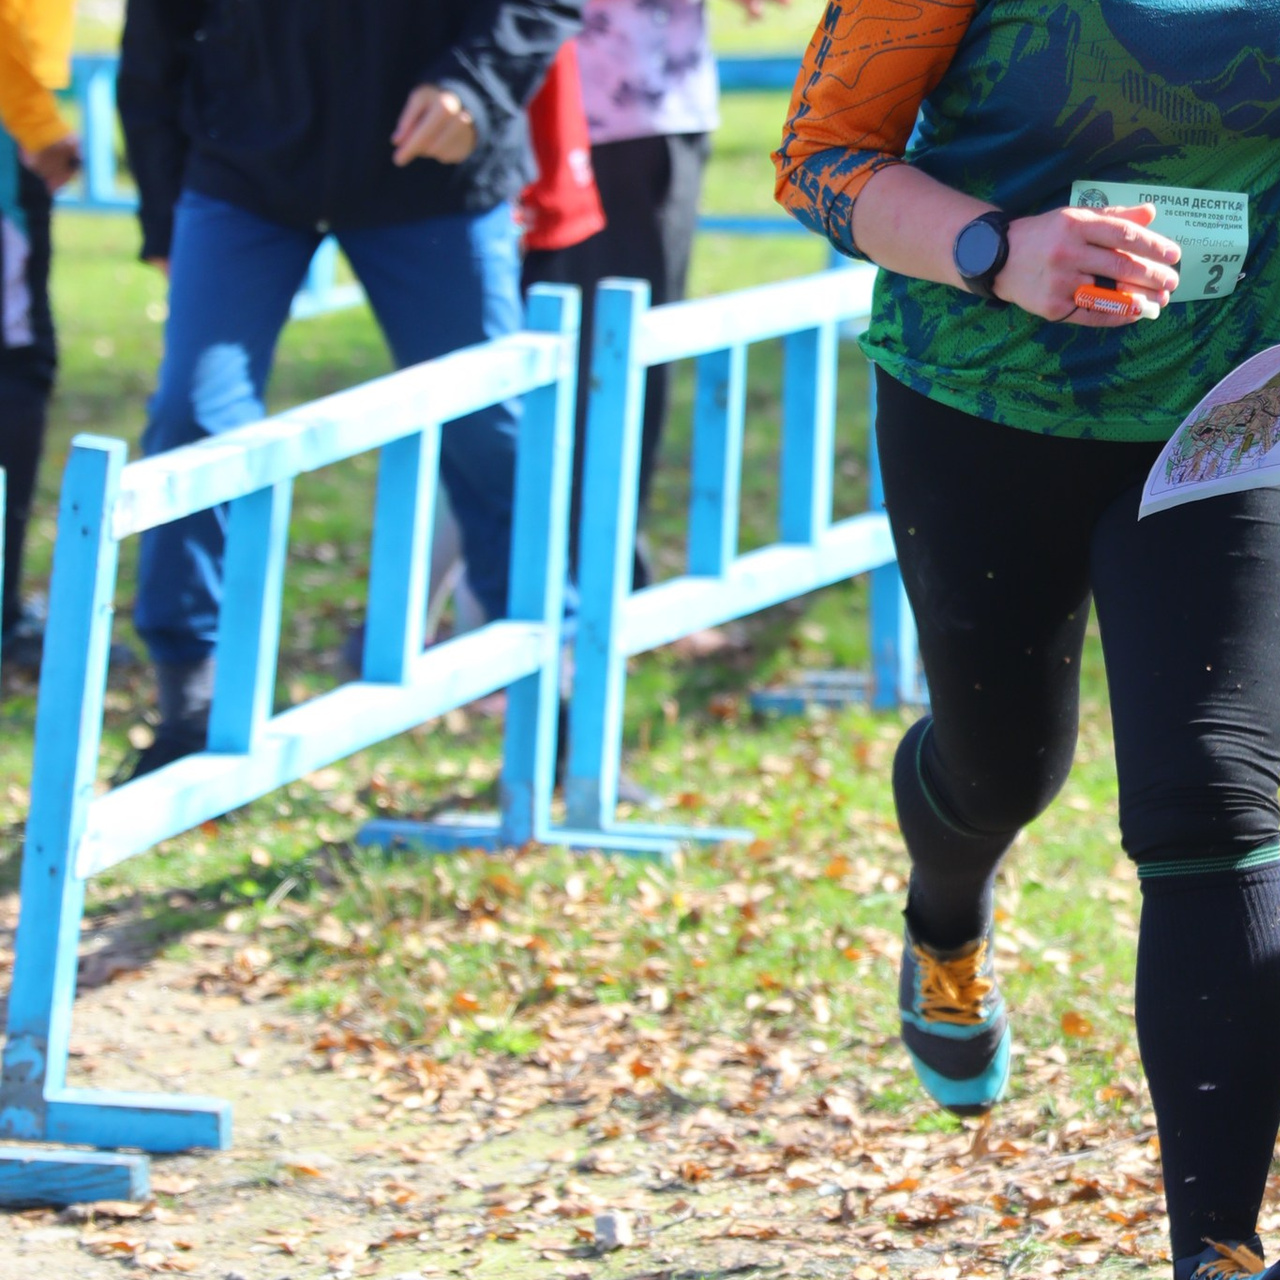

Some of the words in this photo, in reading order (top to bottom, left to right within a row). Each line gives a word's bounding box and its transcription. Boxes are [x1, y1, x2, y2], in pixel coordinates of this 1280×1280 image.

[1139, 193, 1189, 207] ГОРЯЧАЯ
[1191, 198, 1243, 211] ДЕСЯТКА
[1174, 210, 1207, 218] СЕНТЯБРЯ
[1175, 235, 1234, 247] Челябинск
[1201, 254, 1241, 263] ЭТАП
[1203, 264, 1224, 295] 2
